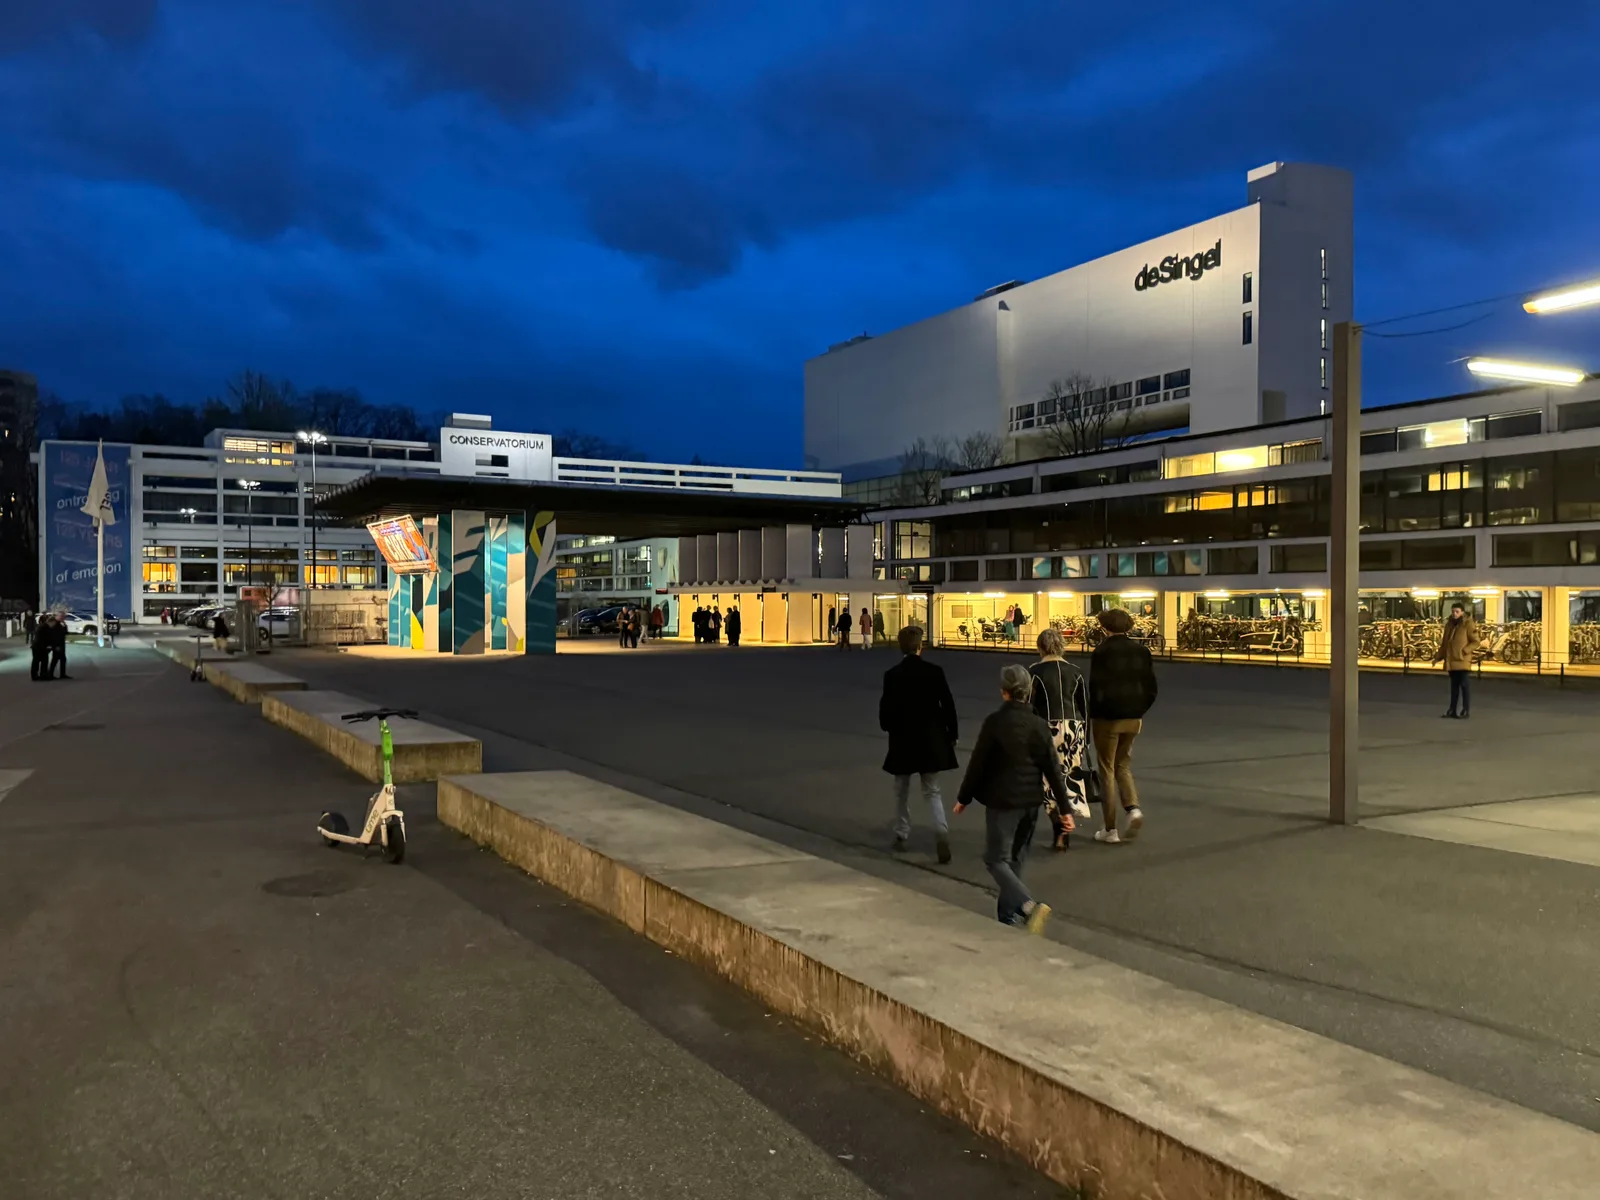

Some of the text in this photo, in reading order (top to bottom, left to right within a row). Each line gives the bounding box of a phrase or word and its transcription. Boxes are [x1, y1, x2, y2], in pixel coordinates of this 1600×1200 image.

[1134, 238, 1221, 291] deSingel
[449, 434, 544, 450] CONSERVATORIUM
[56, 562, 122, 583] of emoion
